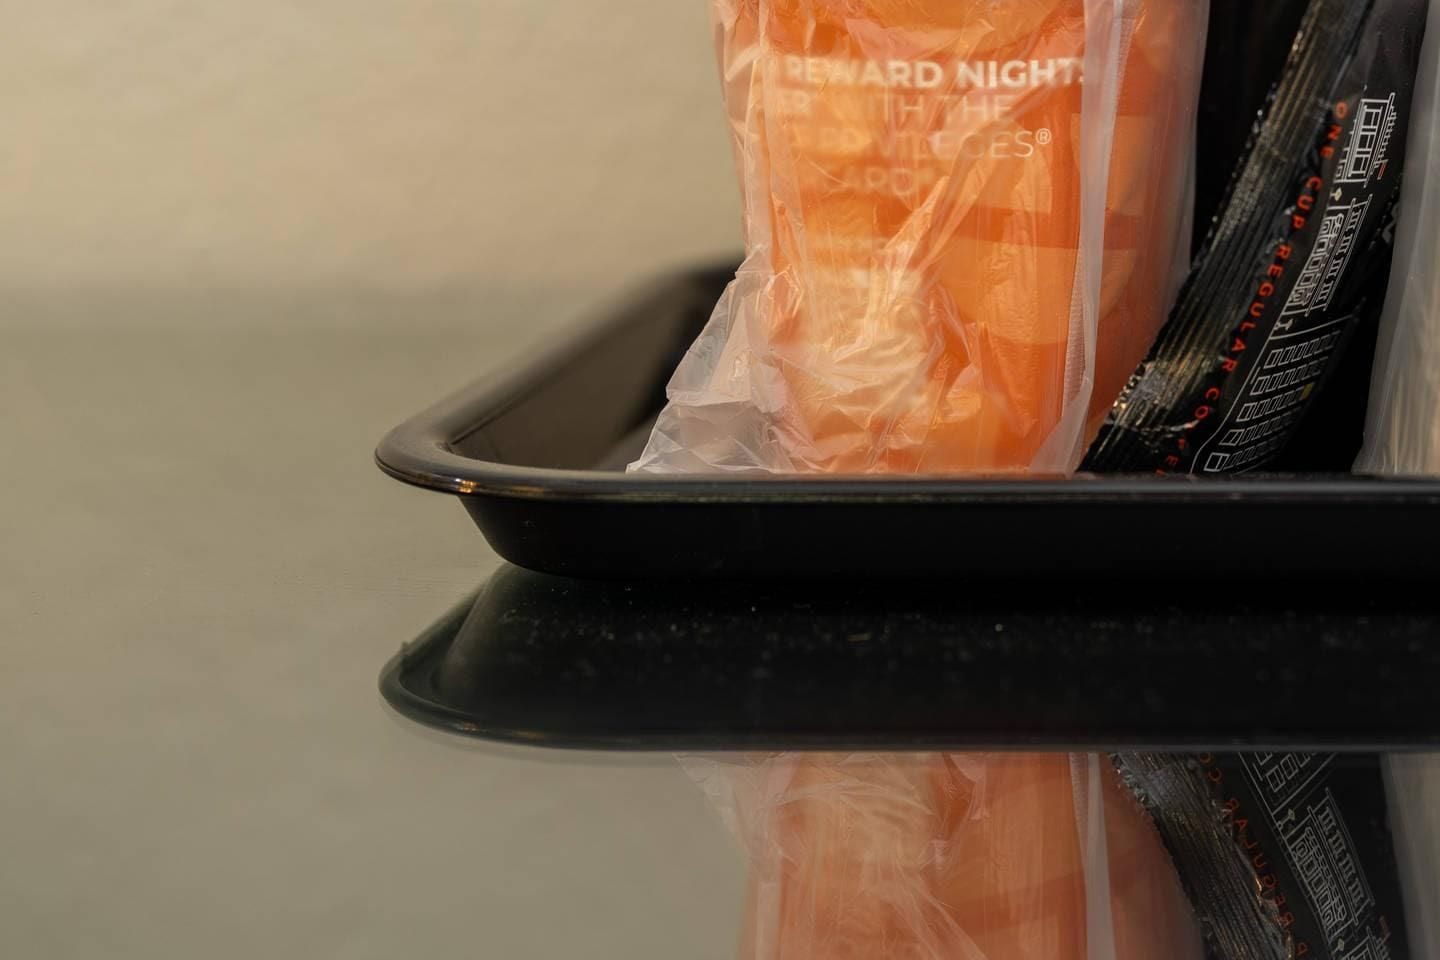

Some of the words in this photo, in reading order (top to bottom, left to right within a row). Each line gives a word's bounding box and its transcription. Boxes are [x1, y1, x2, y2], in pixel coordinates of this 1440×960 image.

[785, 56, 944, 88] REWARD
[1319, 101, 1349, 160] ONE
[1290, 175, 1323, 231] CUP
[1221, 244, 1291, 373] REGULAR
